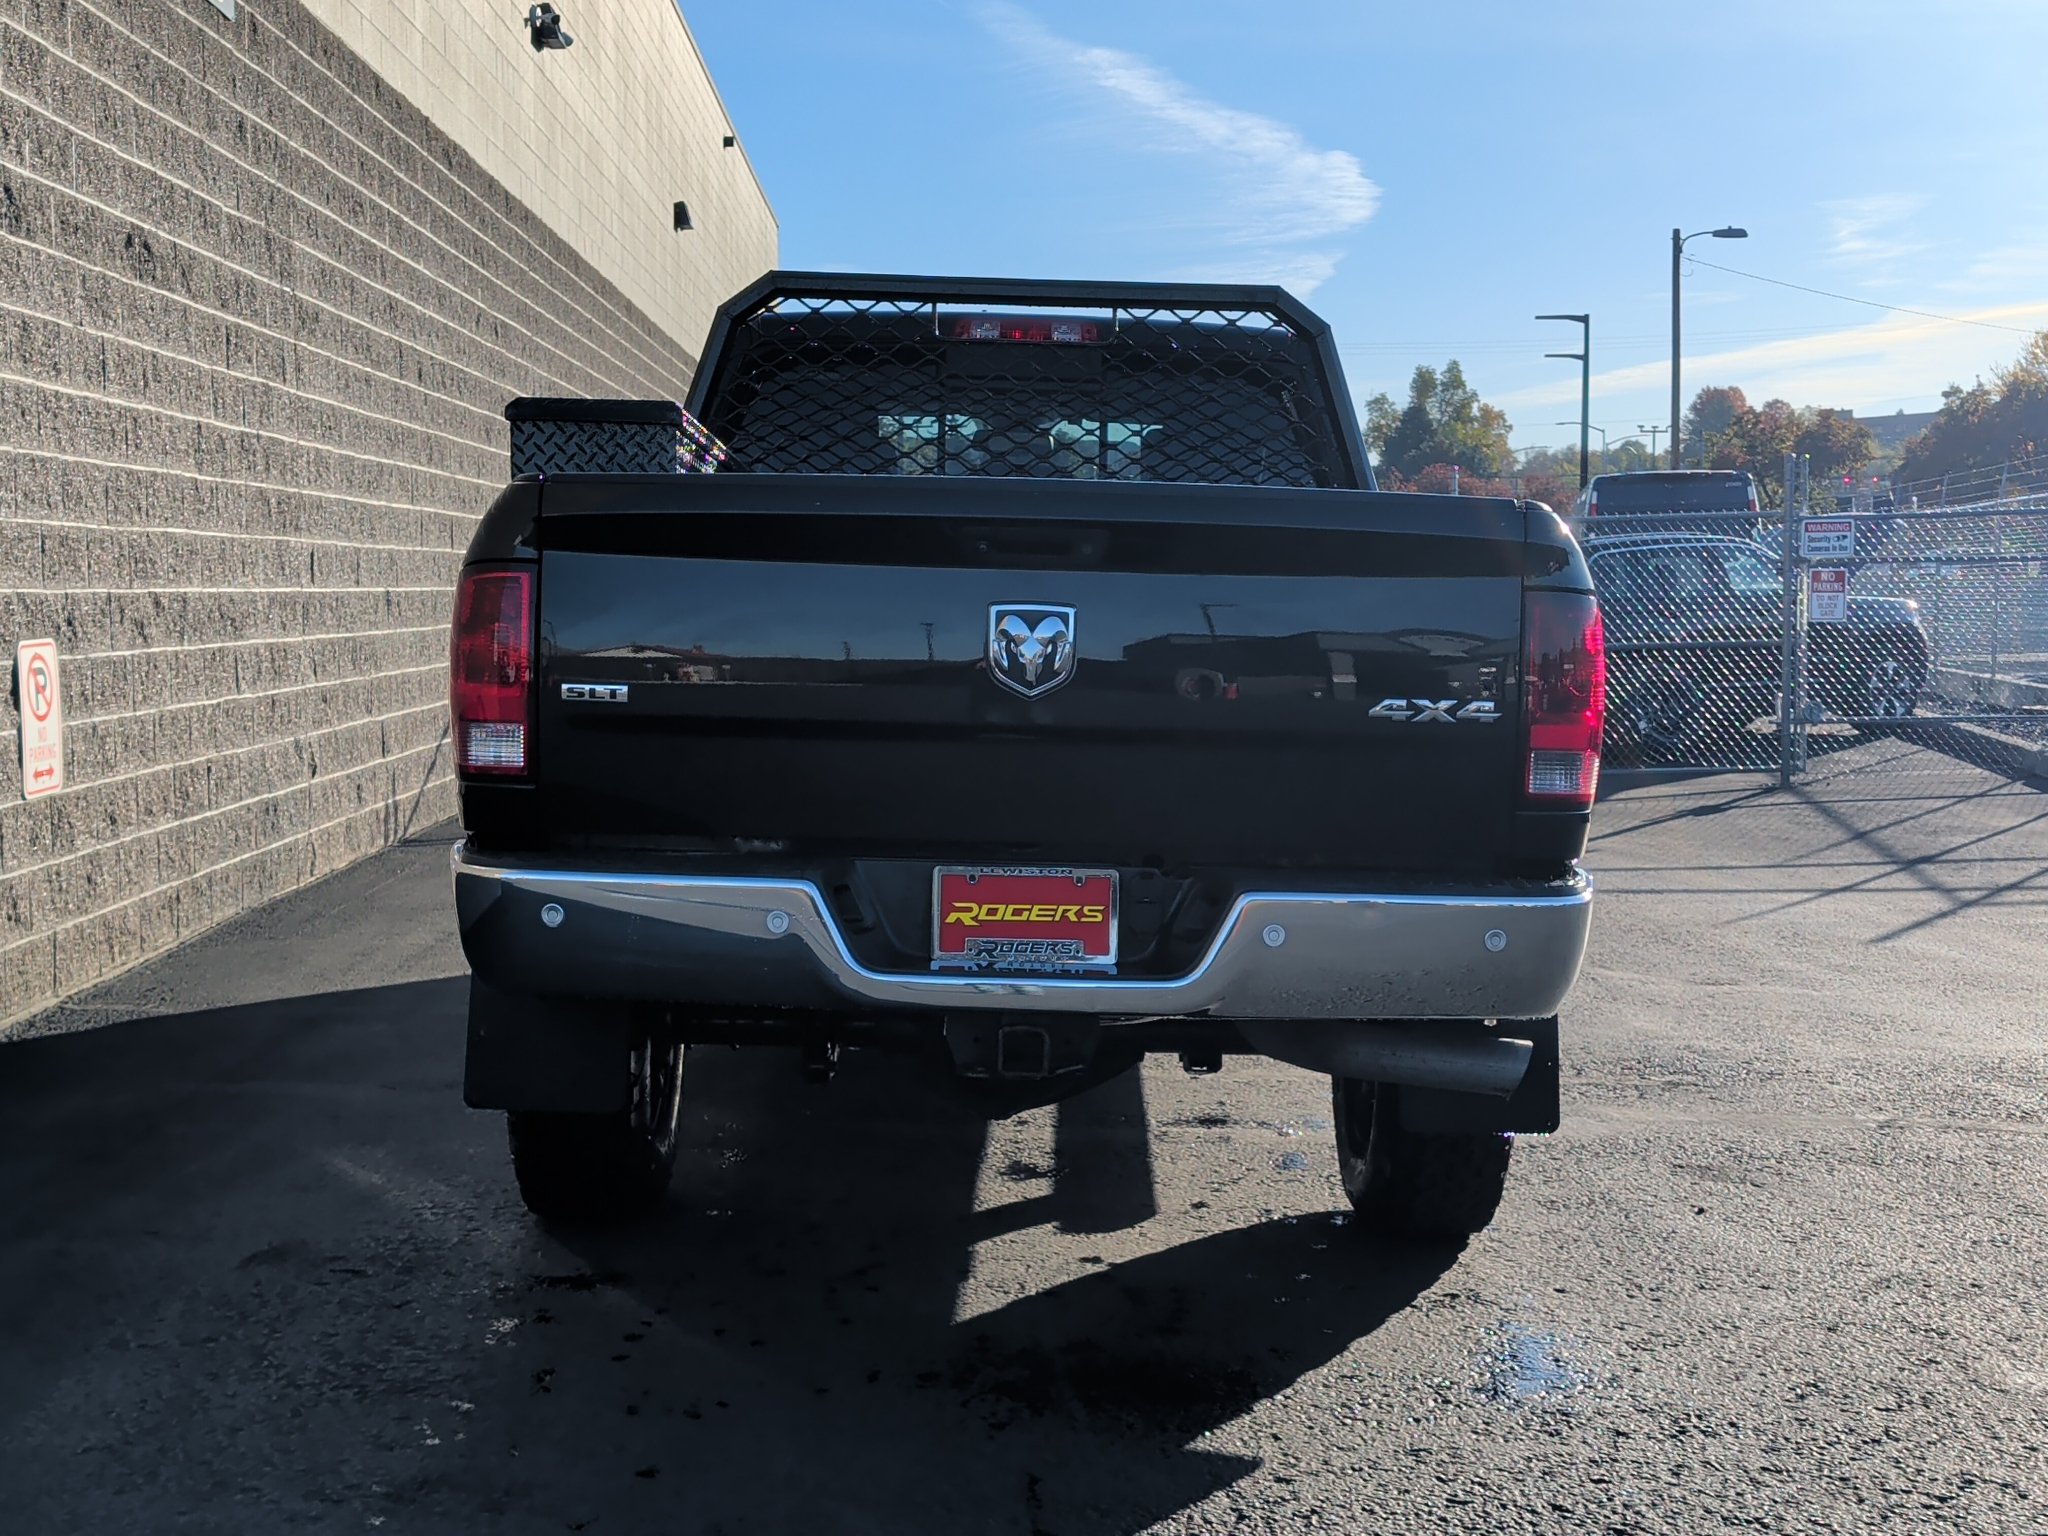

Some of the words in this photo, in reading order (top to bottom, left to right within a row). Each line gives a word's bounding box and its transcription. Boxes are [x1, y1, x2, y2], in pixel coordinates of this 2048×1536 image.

[1807, 523, 1850, 531] WARNING
[1807, 535, 1831, 543] Security
[1820, 571, 1836, 581] NO
[1813, 582, 1844, 591] PARKING
[1816, 594, 1825, 602] DO
[566, 686, 623, 700] SLT
[37, 726, 48, 743] NO
[28, 743, 57, 764] PARKING
[980, 867, 1073, 877] LEWISTON
[944, 902, 1106, 926] ROGERS
[973, 940, 1076, 961] ROGERS
